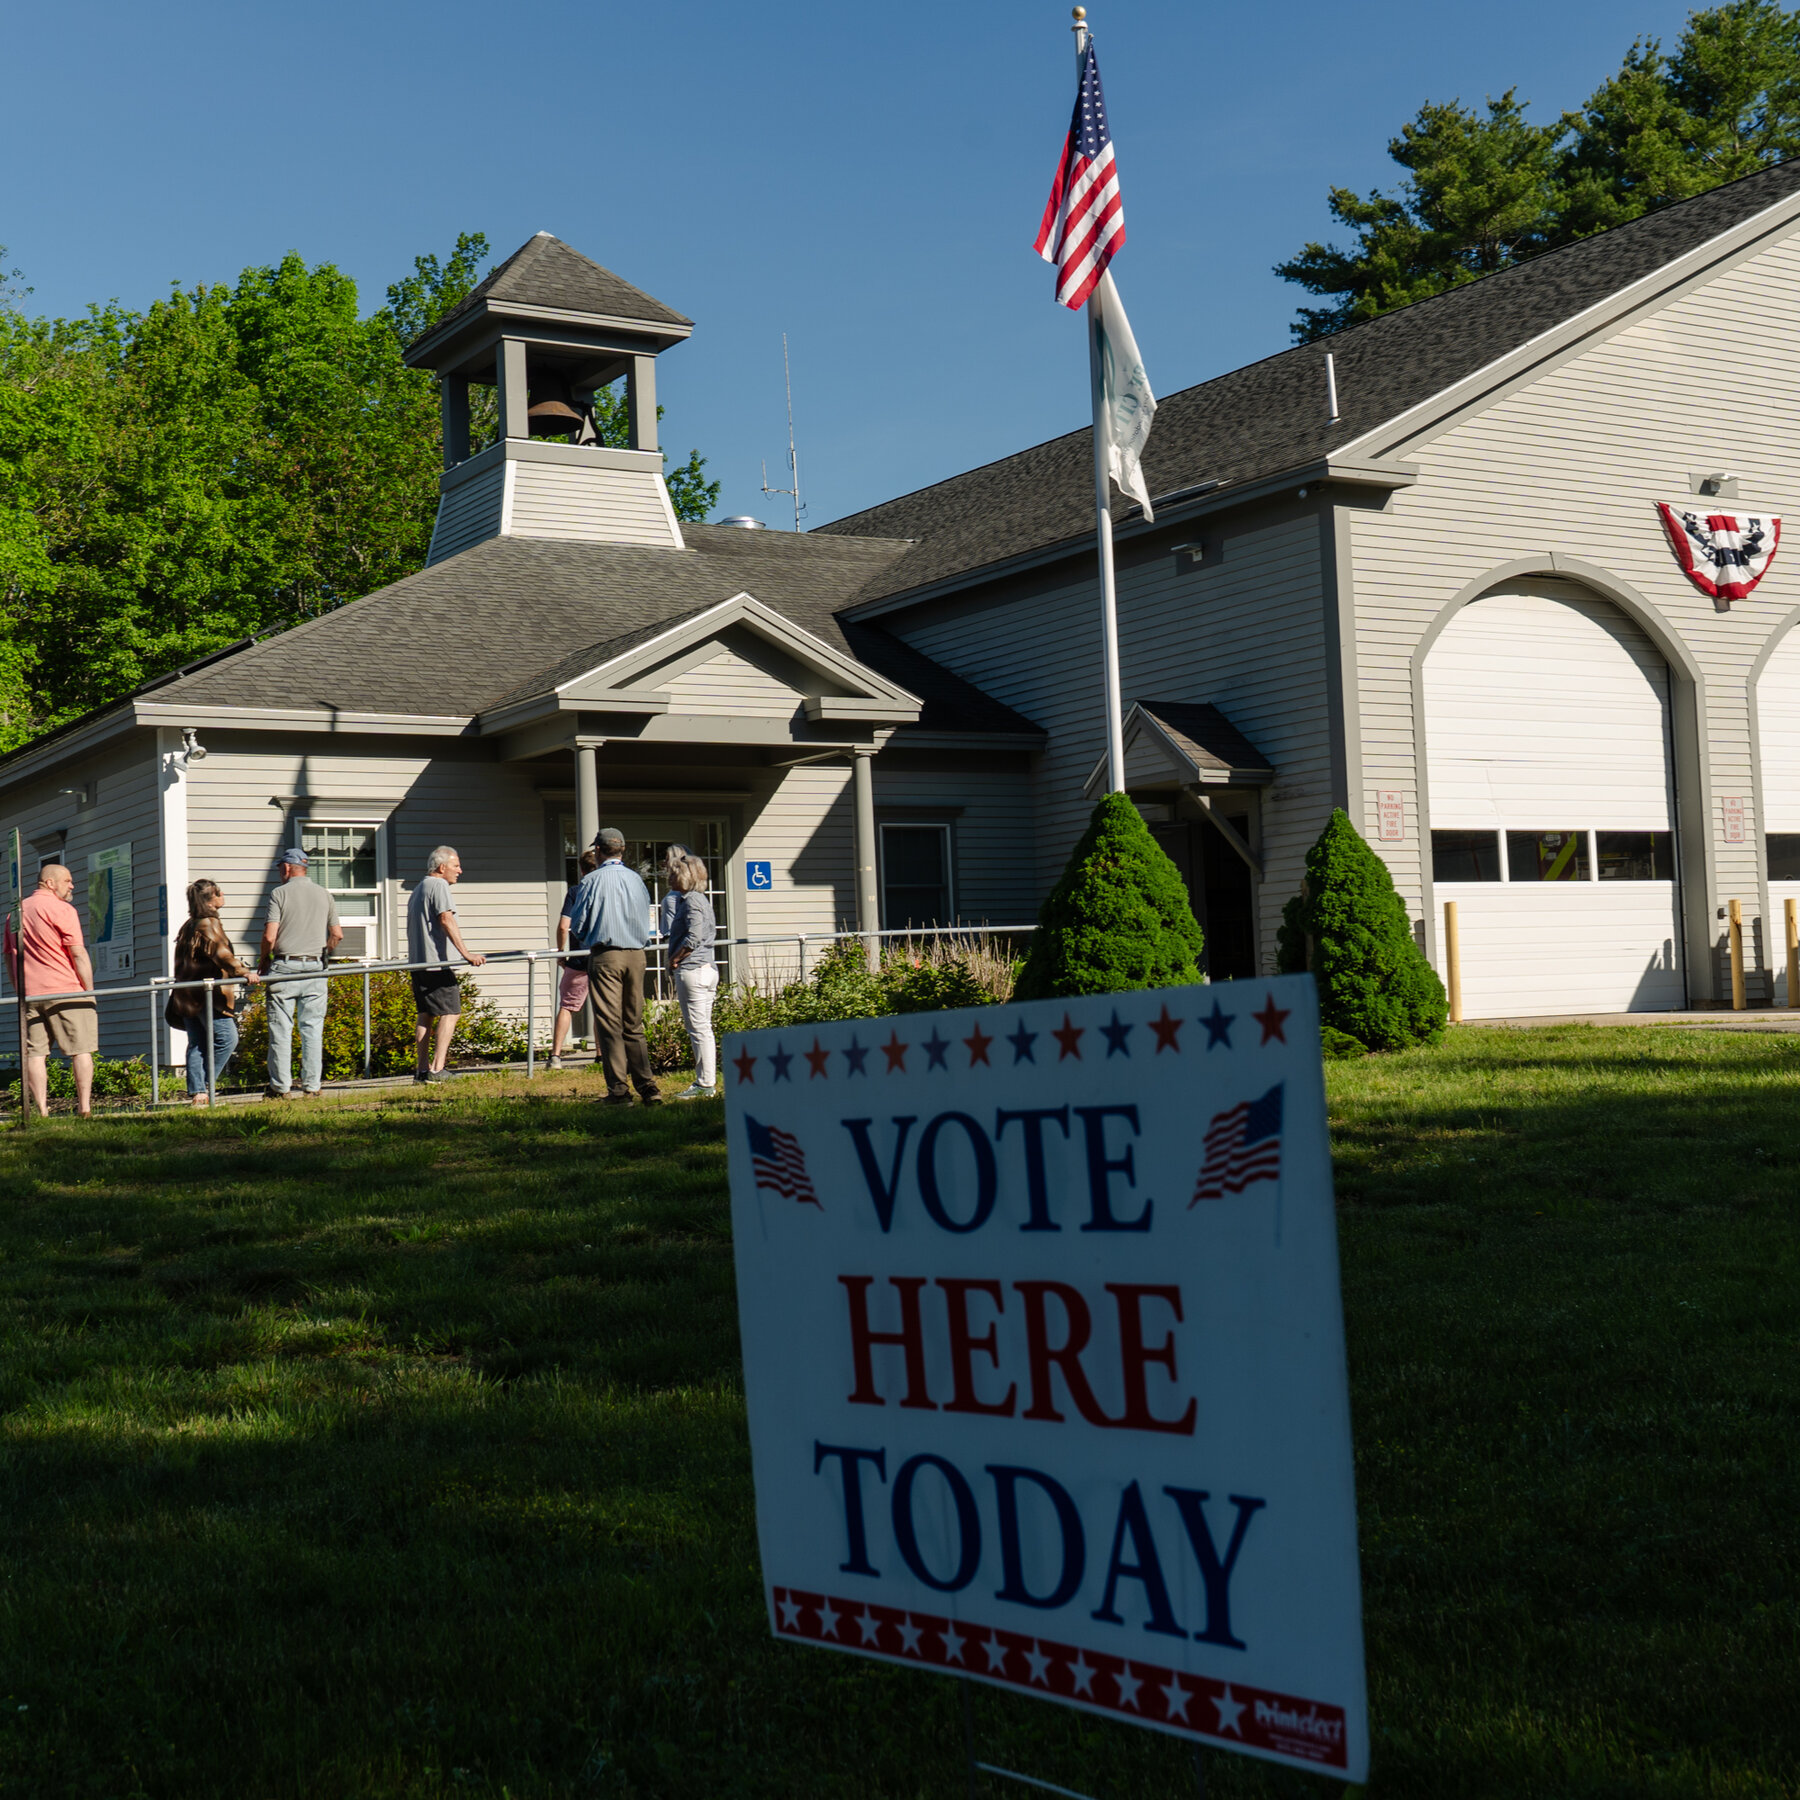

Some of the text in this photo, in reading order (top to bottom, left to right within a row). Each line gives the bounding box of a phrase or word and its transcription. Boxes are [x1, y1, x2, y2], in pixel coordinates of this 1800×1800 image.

[1385, 829, 1399, 837] DOOR
[840, 1103, 1154, 1234] VOTE
[837, 1274, 1198, 1437] HERE
[813, 1439, 1266, 1651] TODAY
